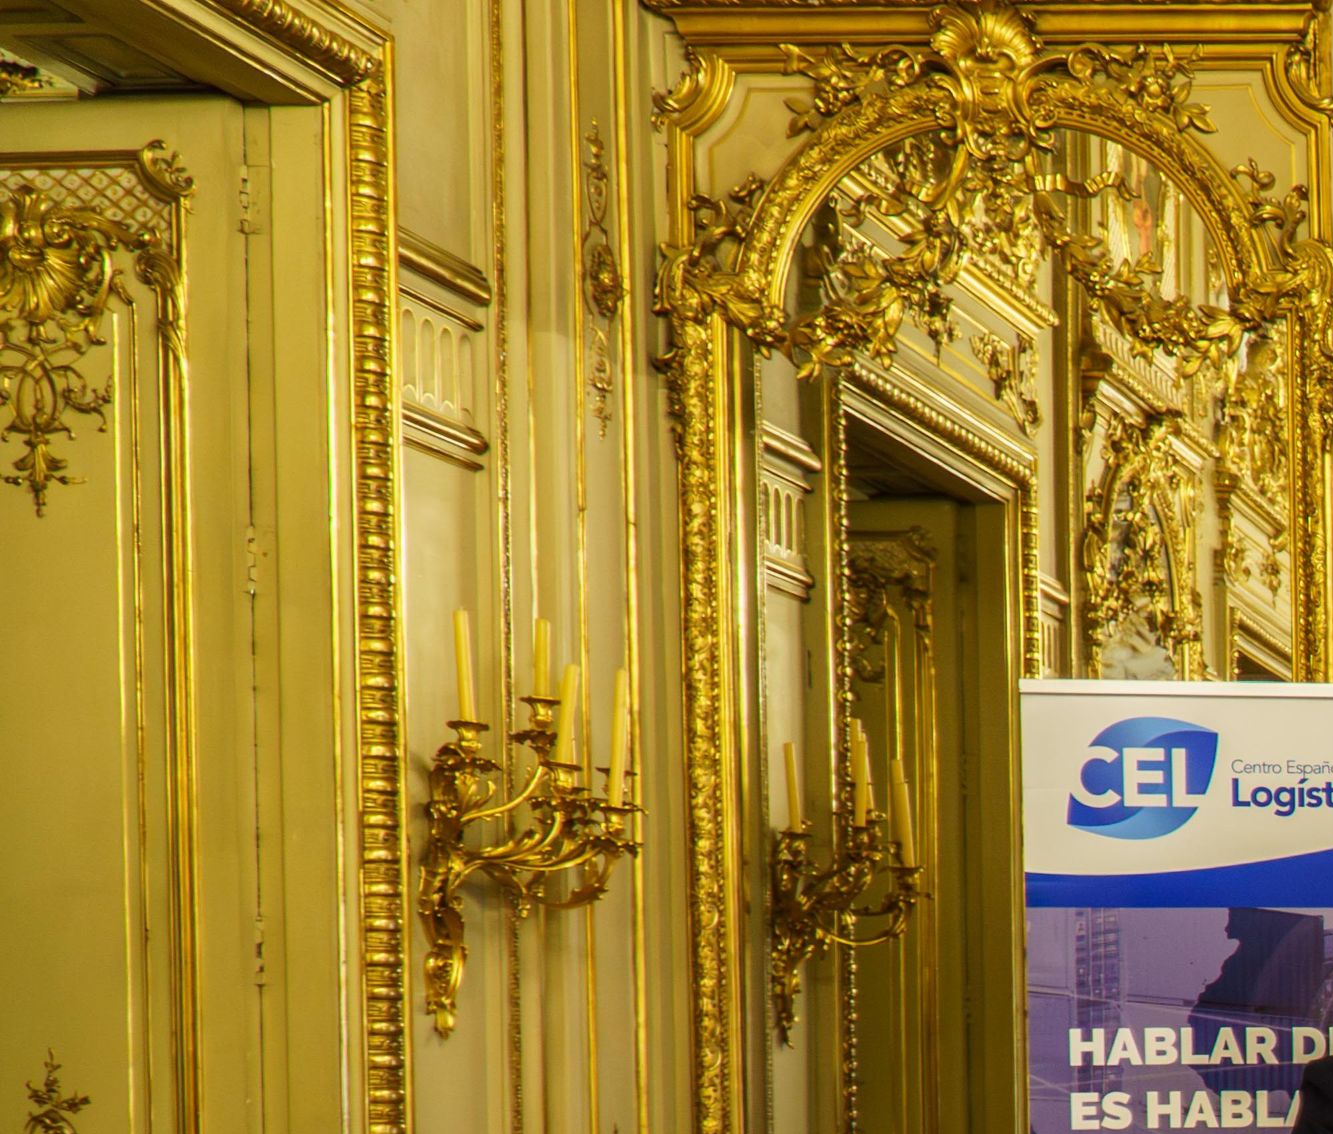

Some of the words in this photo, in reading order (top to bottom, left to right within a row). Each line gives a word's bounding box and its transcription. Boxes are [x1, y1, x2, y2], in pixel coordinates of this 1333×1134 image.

[1071, 745, 1206, 808] CEL
[1231, 759, 1282, 775] Centro
[1069, 1027, 1280, 1066] HABLAR
[1070, 1091, 1132, 1130] ES
